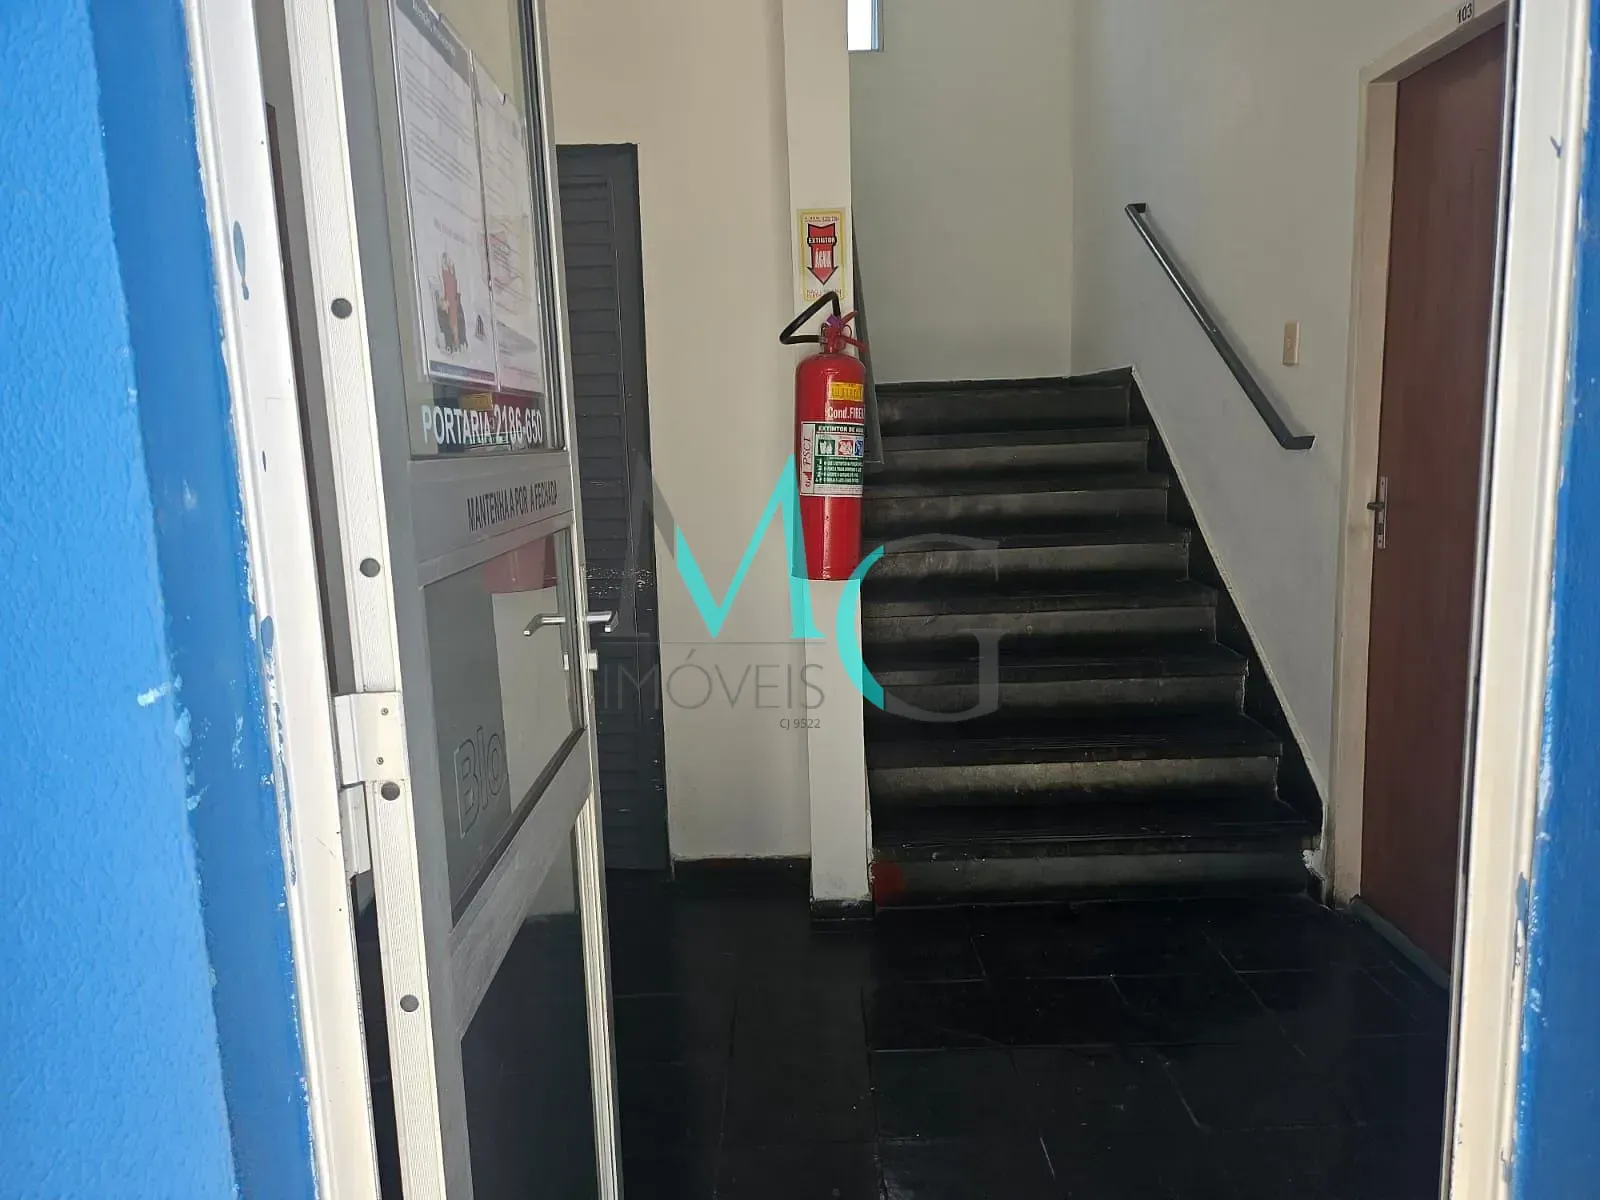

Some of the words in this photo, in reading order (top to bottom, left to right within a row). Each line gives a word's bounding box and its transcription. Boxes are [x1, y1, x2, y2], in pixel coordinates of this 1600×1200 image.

[1457, 4, 1473, 23] 103
[808, 236, 836, 244] EXTINTOR
[421, 404, 493, 445] PORTARIA
